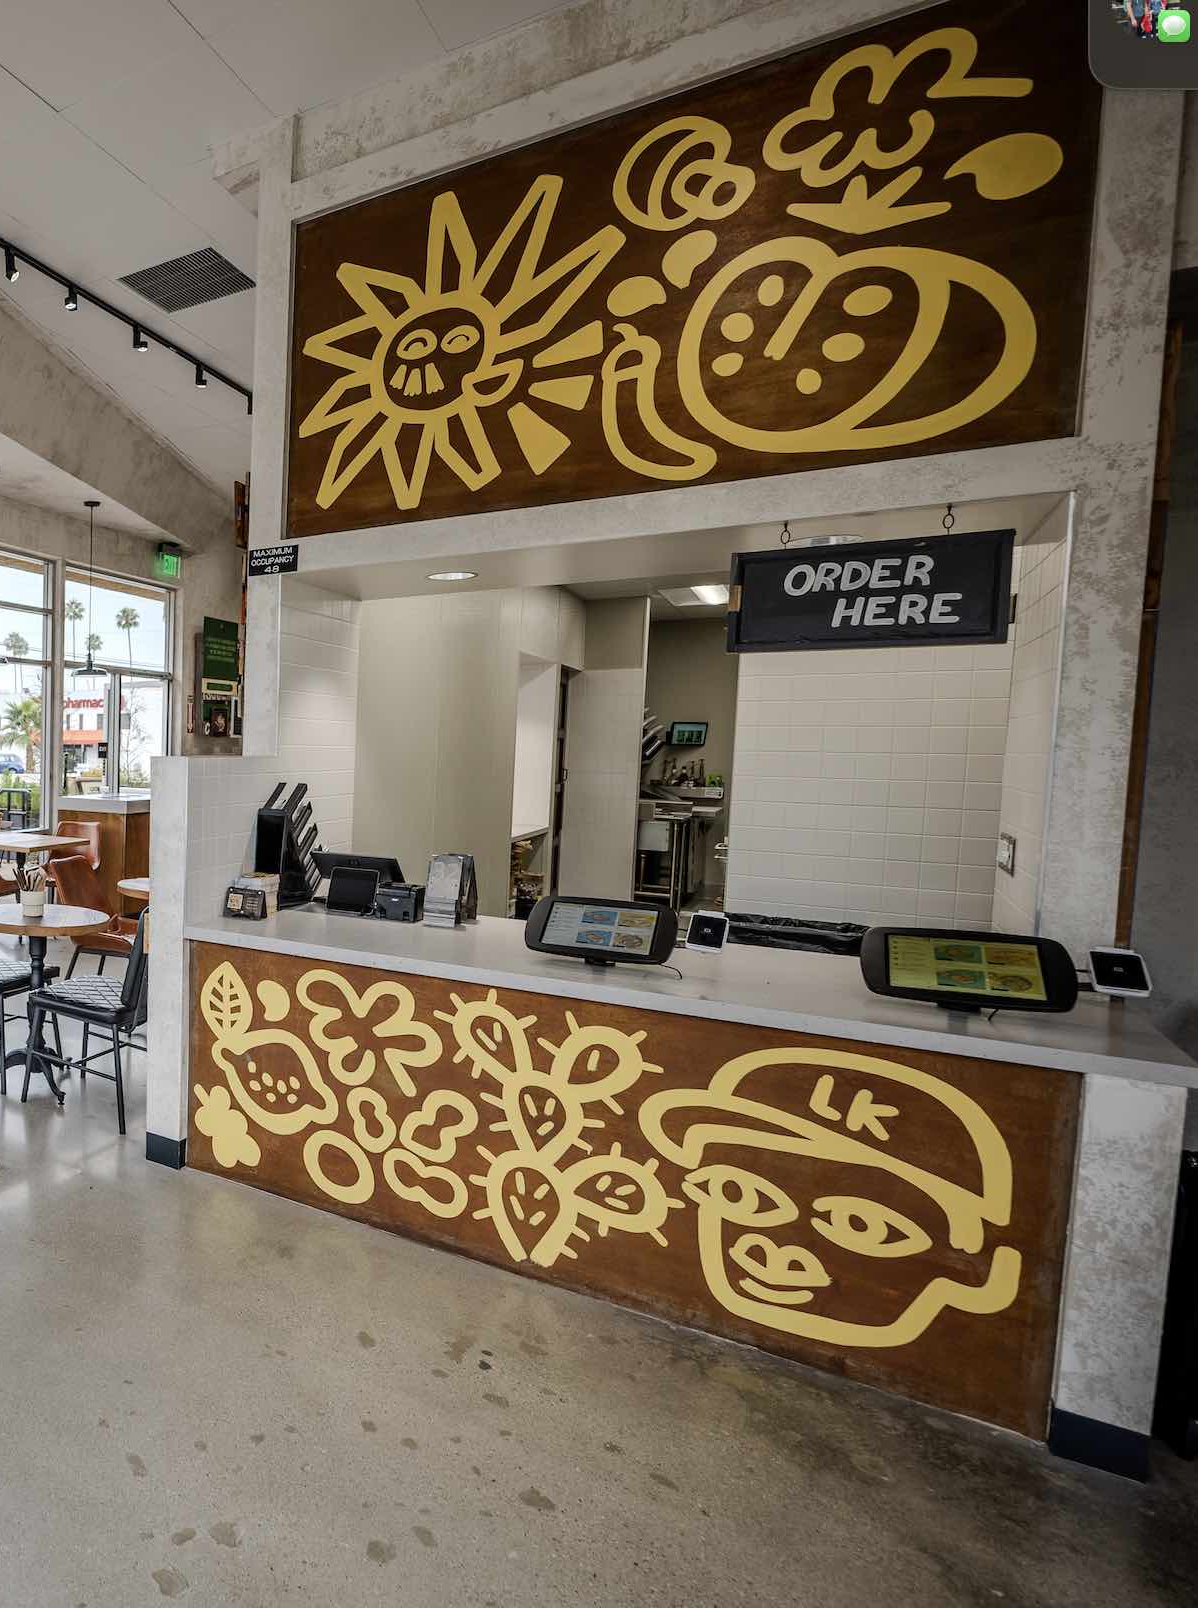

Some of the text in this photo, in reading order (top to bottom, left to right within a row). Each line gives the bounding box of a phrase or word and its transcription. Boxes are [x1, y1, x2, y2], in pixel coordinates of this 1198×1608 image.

[253, 547, 293, 558] MAXIMUM
[250, 555, 295, 567] OCCUPANCY
[264, 565, 280, 573] 48
[783, 554, 935, 597] ORDER
[831, 592, 963, 628] HERE
[63, 697, 104, 709] harmac
[809, 1074, 900, 1141] LK
